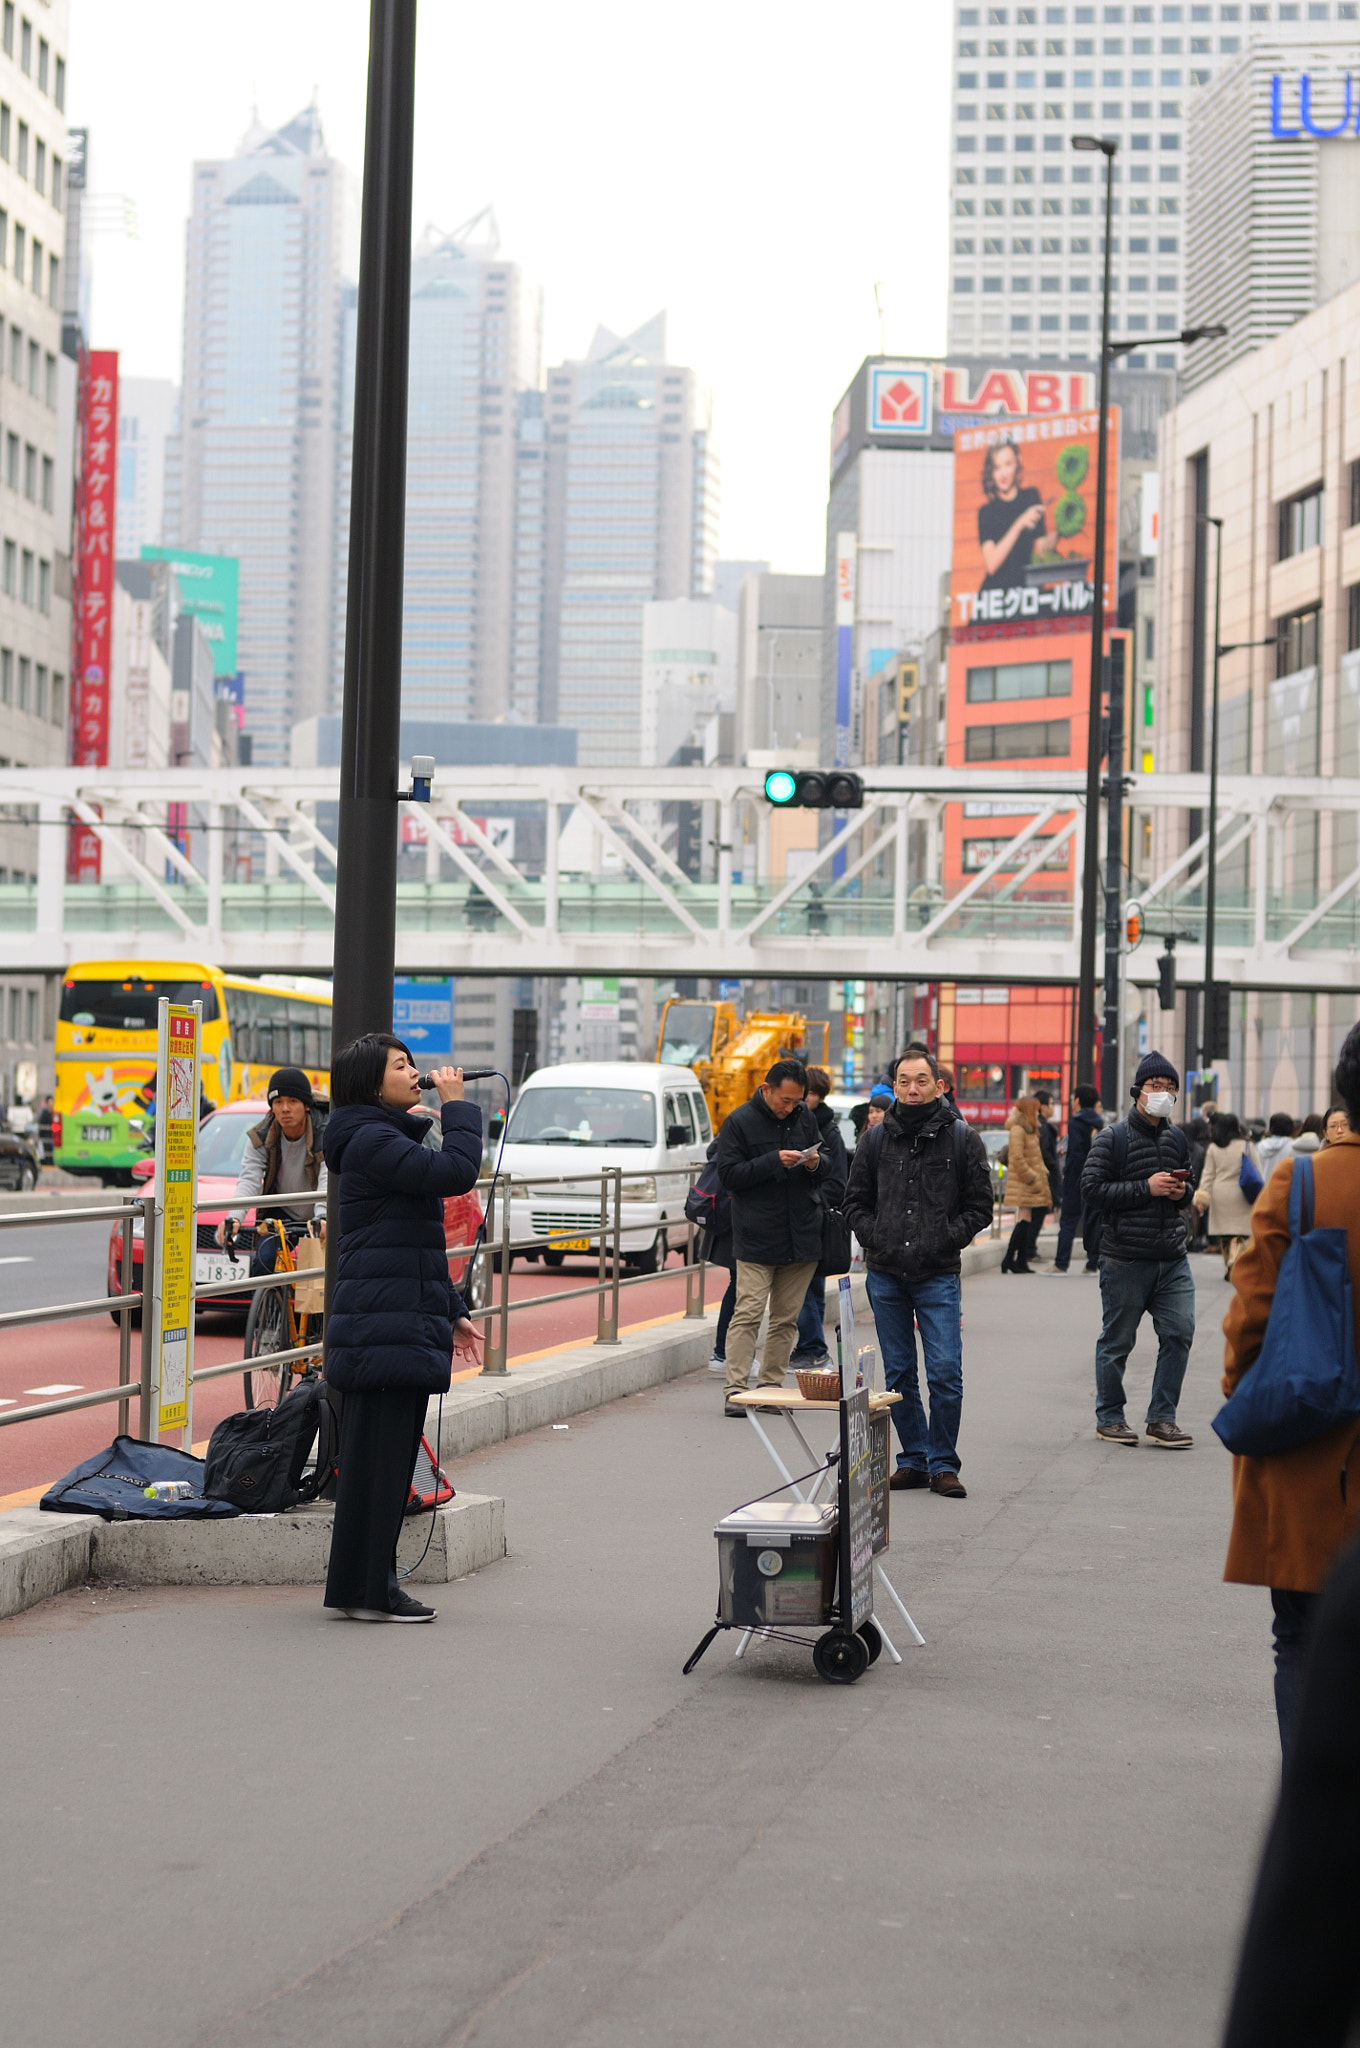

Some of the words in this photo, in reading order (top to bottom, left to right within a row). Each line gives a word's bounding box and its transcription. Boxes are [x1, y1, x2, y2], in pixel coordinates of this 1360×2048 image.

[1269, 73, 1360, 138] LU
[941, 369, 1095, 415] LABI
[207, 1266, 246, 1281] 18-32
